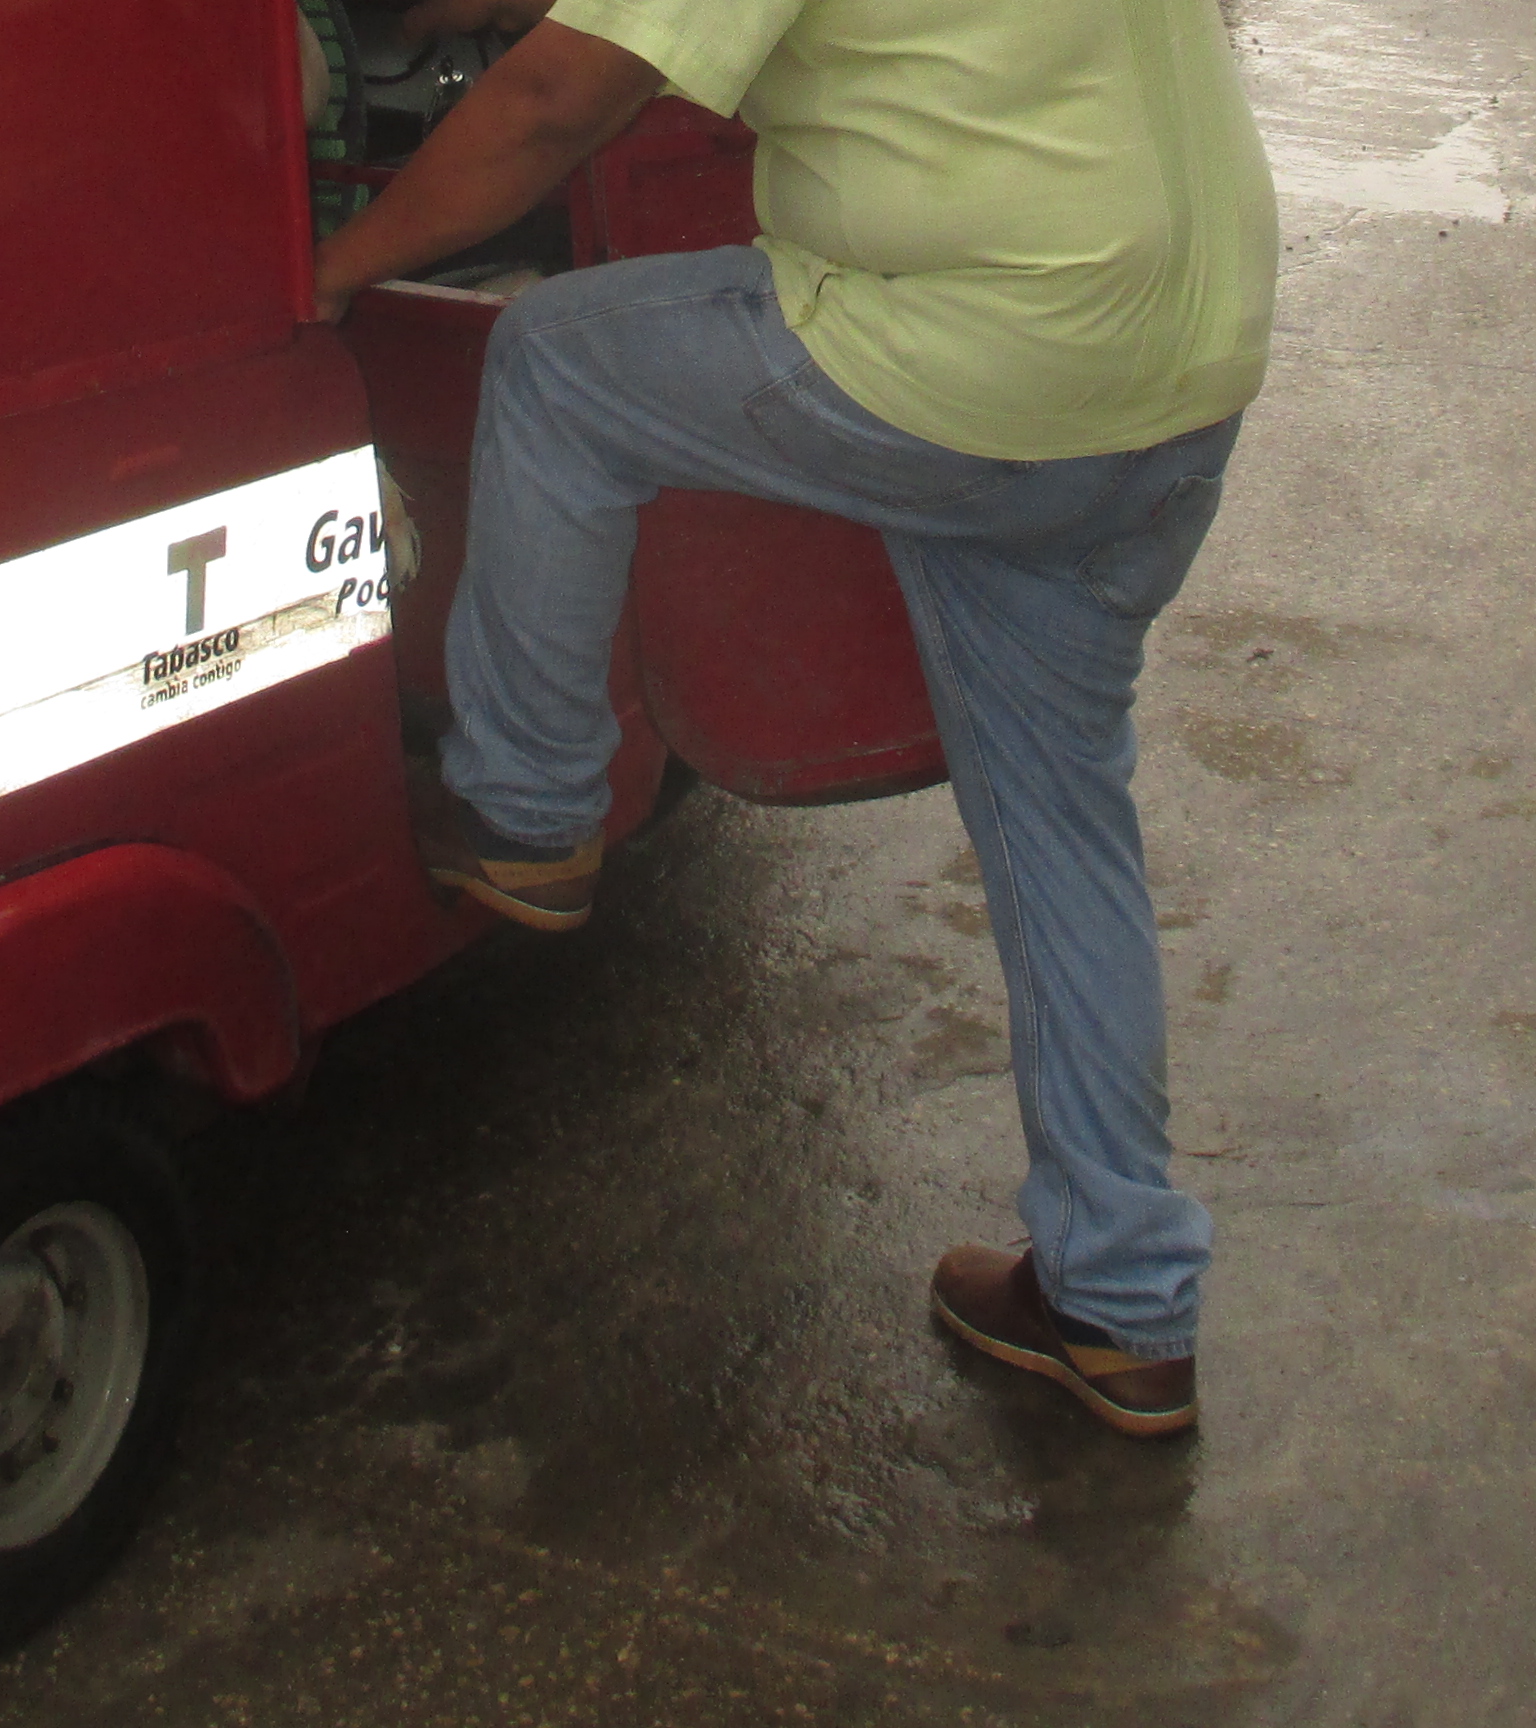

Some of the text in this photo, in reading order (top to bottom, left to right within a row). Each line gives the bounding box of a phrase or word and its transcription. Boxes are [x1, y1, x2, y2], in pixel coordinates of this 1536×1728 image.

[140, 655, 242, 711] cambia contigo
[142, 627, 240, 686] Tabasco
